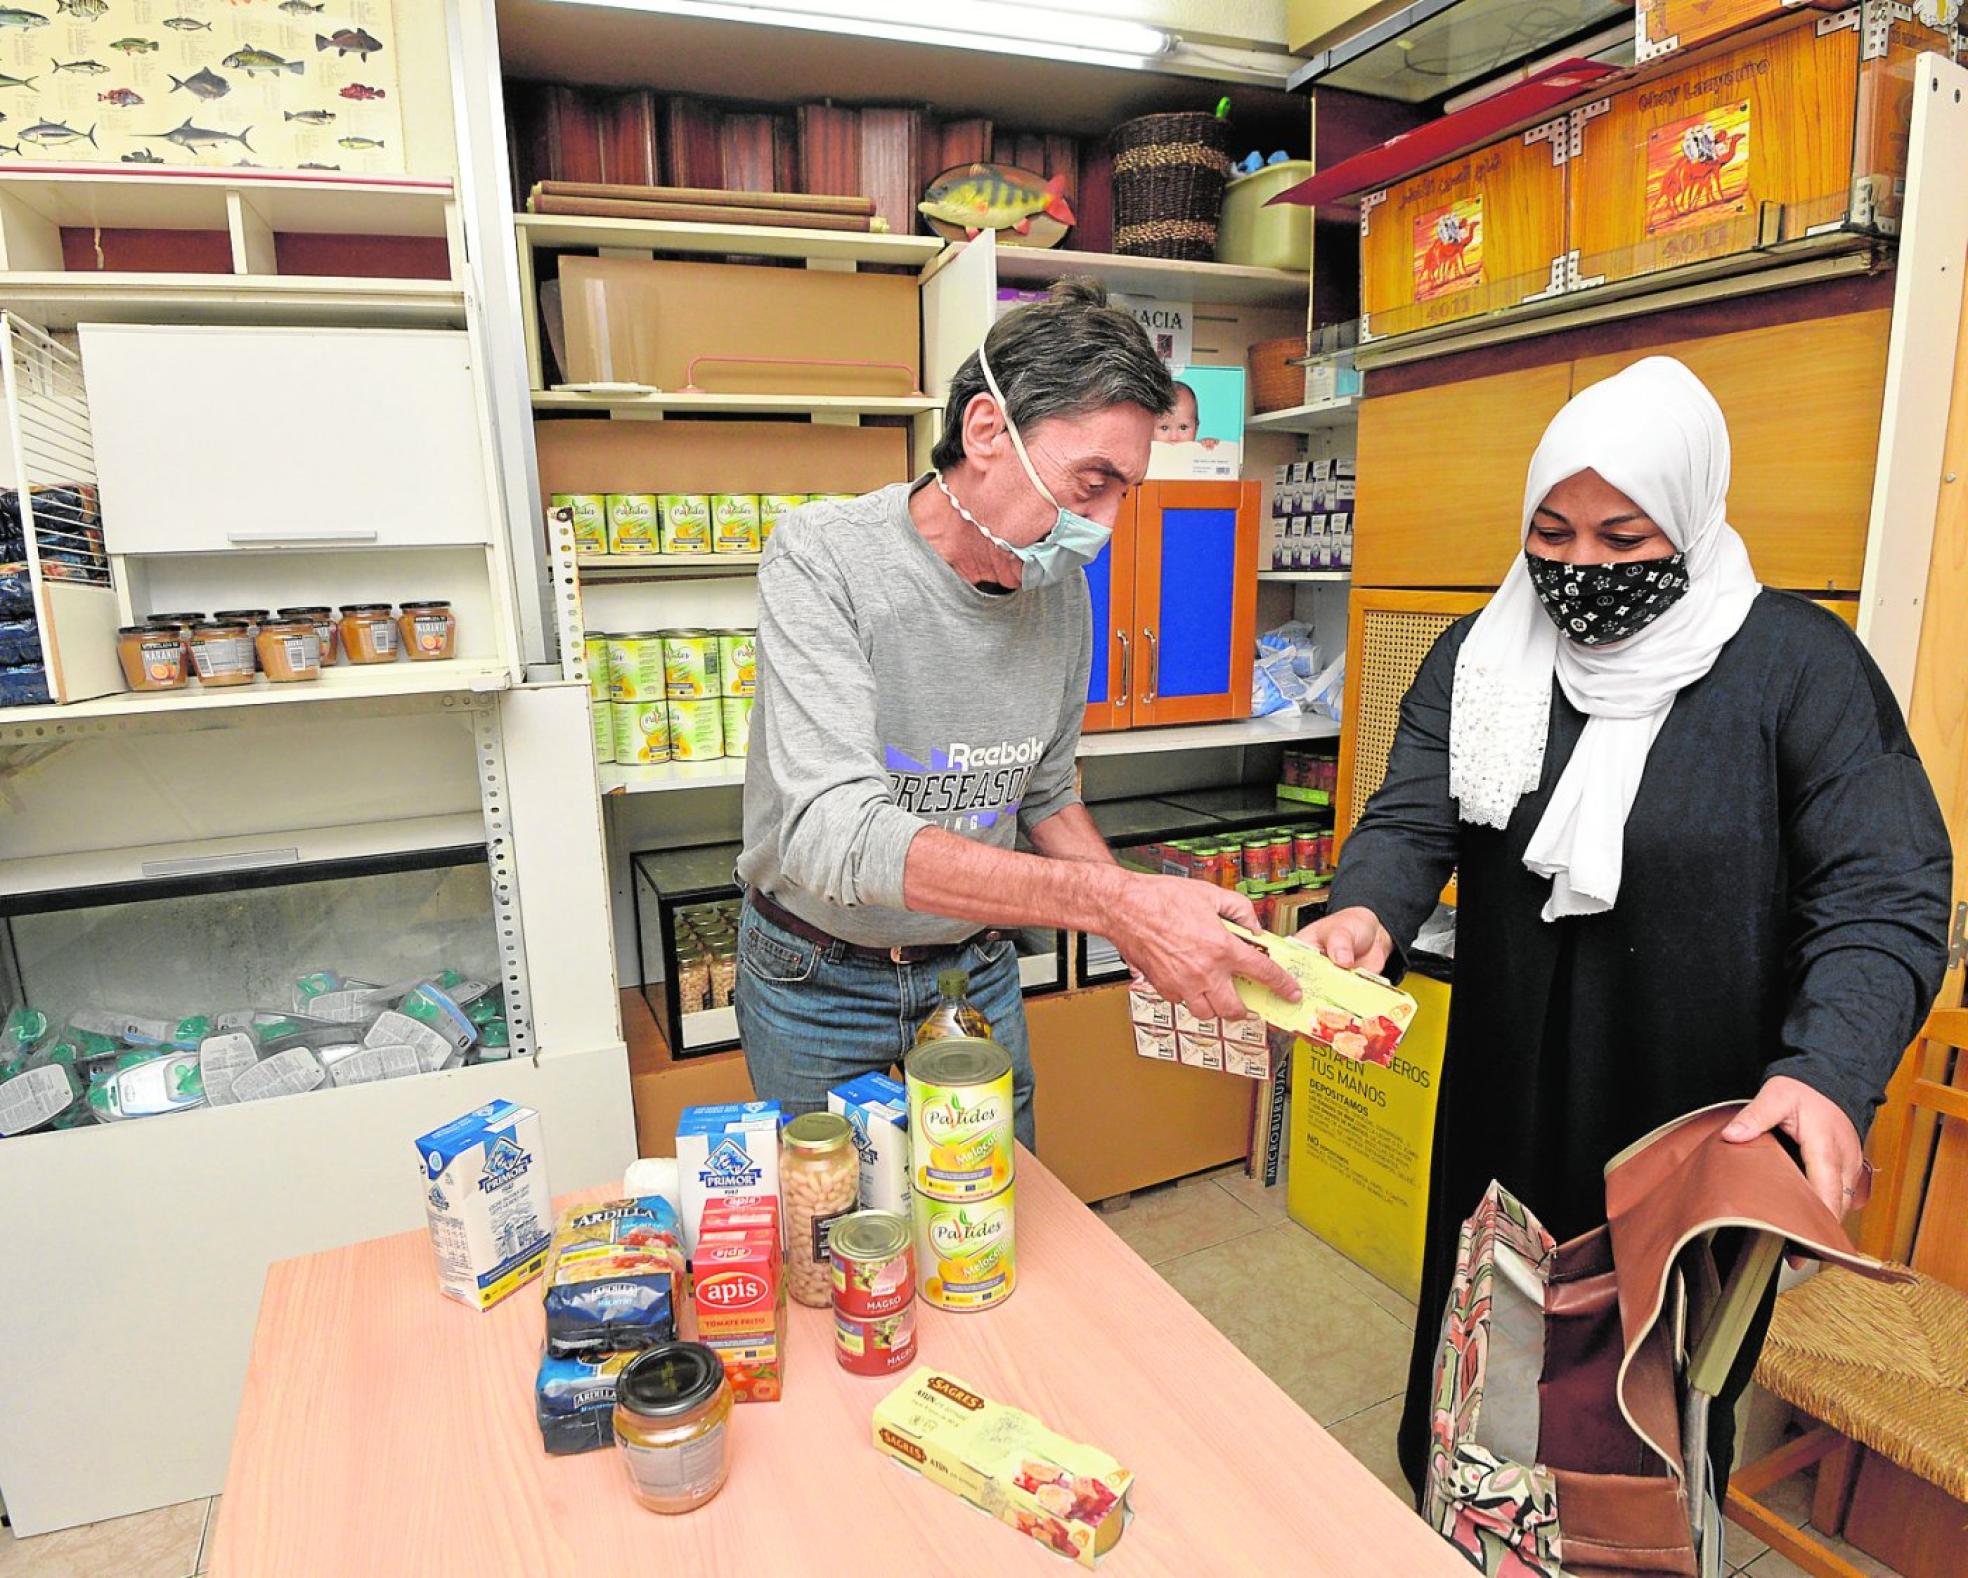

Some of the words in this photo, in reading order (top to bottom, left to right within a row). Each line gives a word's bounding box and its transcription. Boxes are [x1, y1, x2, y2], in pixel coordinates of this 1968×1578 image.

[1132, 309, 1183, 330] ACIA
[946, 736, 1044, 772] Reebok
[1311, 1056, 1335, 1080] TUS
[1338, 1071, 1387, 1107] MANOS
[1346, 1059, 1365, 1076] EN
[1309, 1078, 1369, 1117] DEPOSITAMOS
[485, 1164, 528, 1194] PRIMOR
[707, 1176, 755, 1187] PRIMOR
[707, 1277, 759, 1305] apis
[866, 1295, 902, 1311] MAGRO
[705, 1319, 738, 1328] TOMATE
[933, 1378, 979, 1408] SAGRES
[883, 1431, 923, 1460] SAGRES
